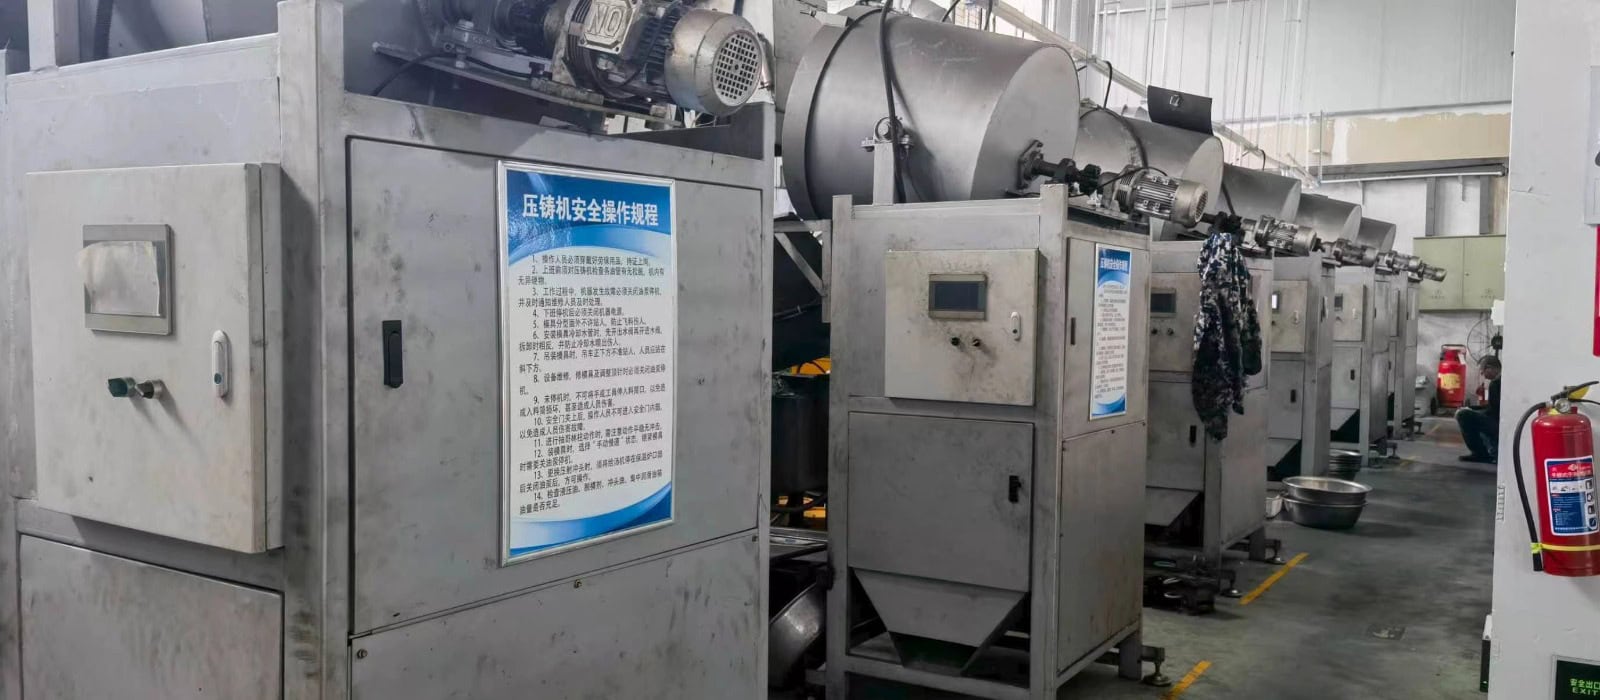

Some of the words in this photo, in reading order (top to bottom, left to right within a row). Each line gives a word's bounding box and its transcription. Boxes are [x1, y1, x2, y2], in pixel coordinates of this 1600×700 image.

[522, 193, 658, 226] 压铸机安全操作规程
[1570, 679, 1600, 690] 安全出口
[1572, 687, 1599, 696] EXIT
